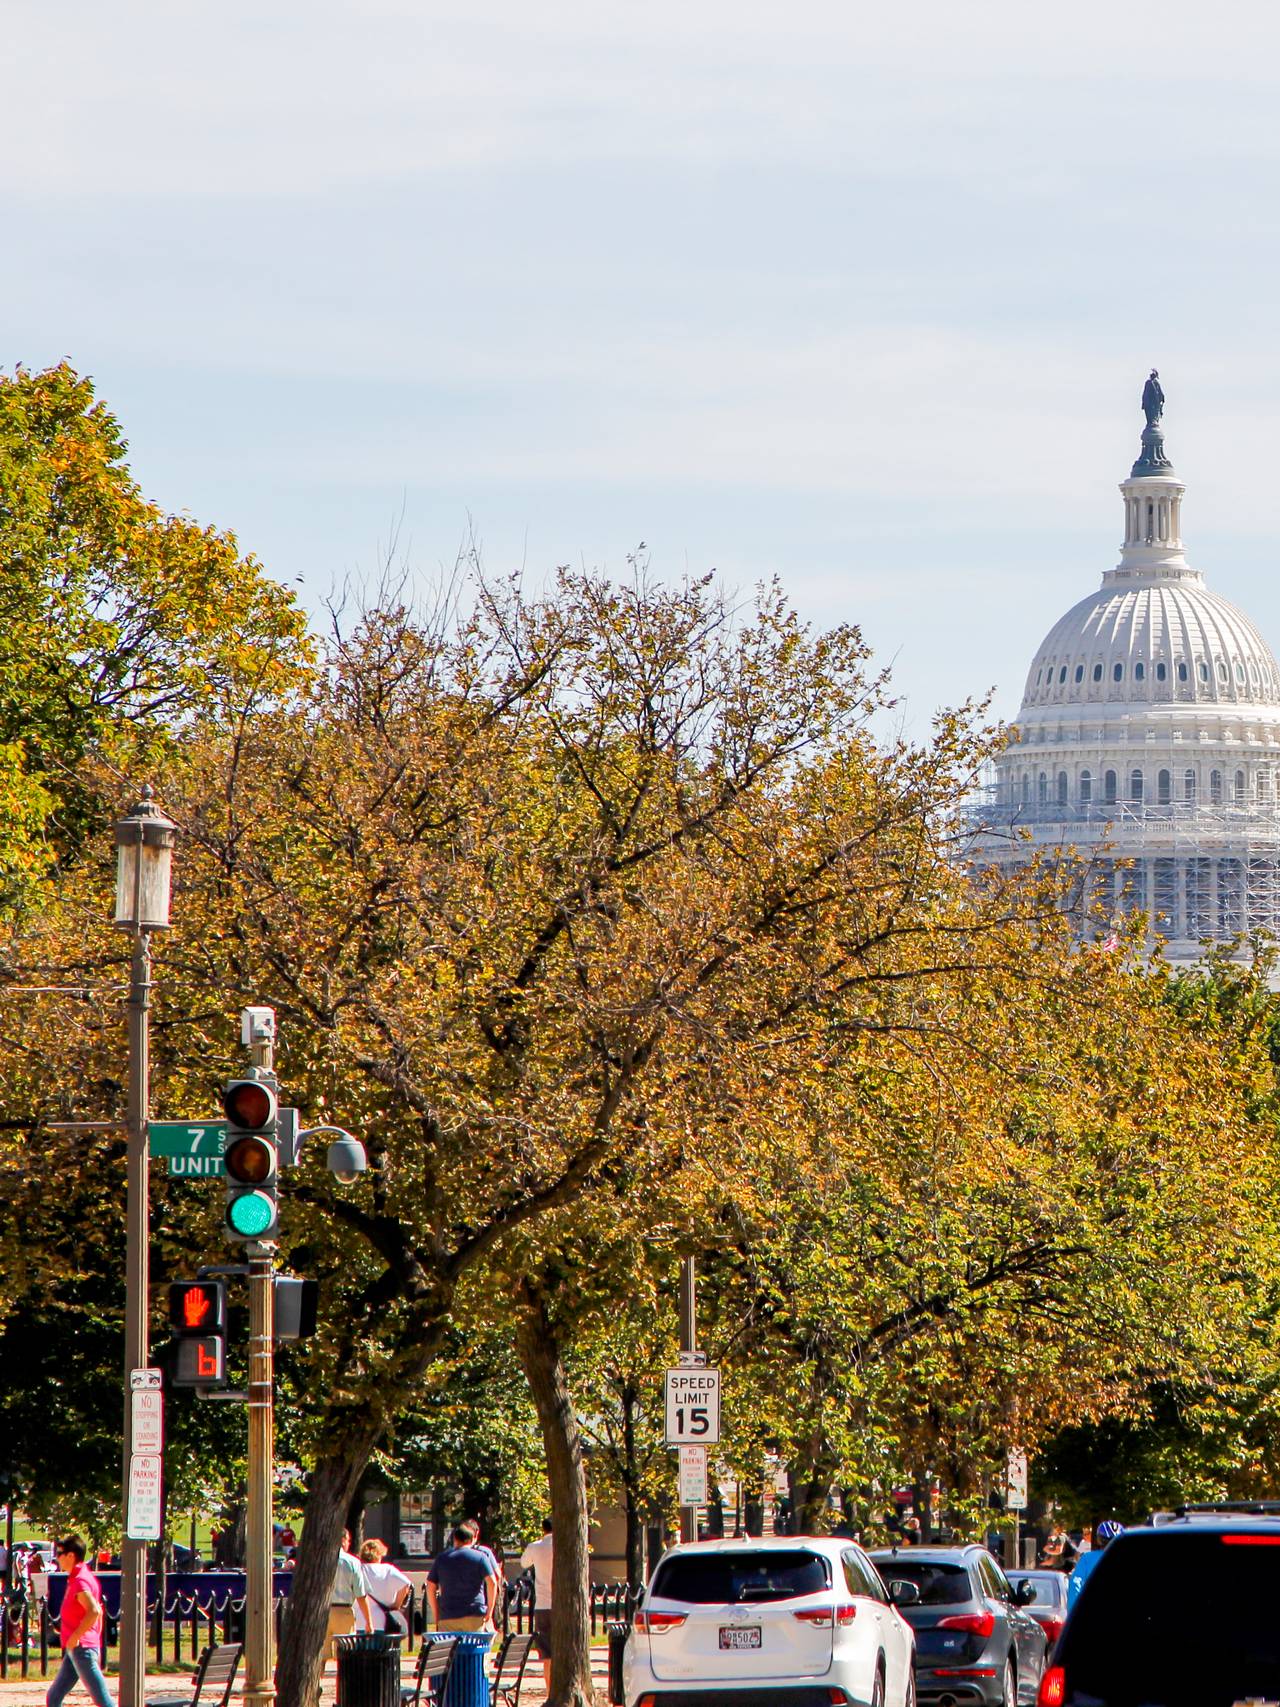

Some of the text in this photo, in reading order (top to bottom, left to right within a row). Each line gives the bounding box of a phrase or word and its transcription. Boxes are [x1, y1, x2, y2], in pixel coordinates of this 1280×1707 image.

[187, 1129, 205, 1153] 7
[172, 1157, 223, 1174] UNIT
[671, 1378, 715, 1389] SPEED
[141, 1394, 152, 1408] NO
[675, 1393, 710, 1404] LIMIT
[676, 1408, 709, 1435] 15
[141, 1459, 150, 1469] NO
[133, 1471, 157, 1479] PARKING
